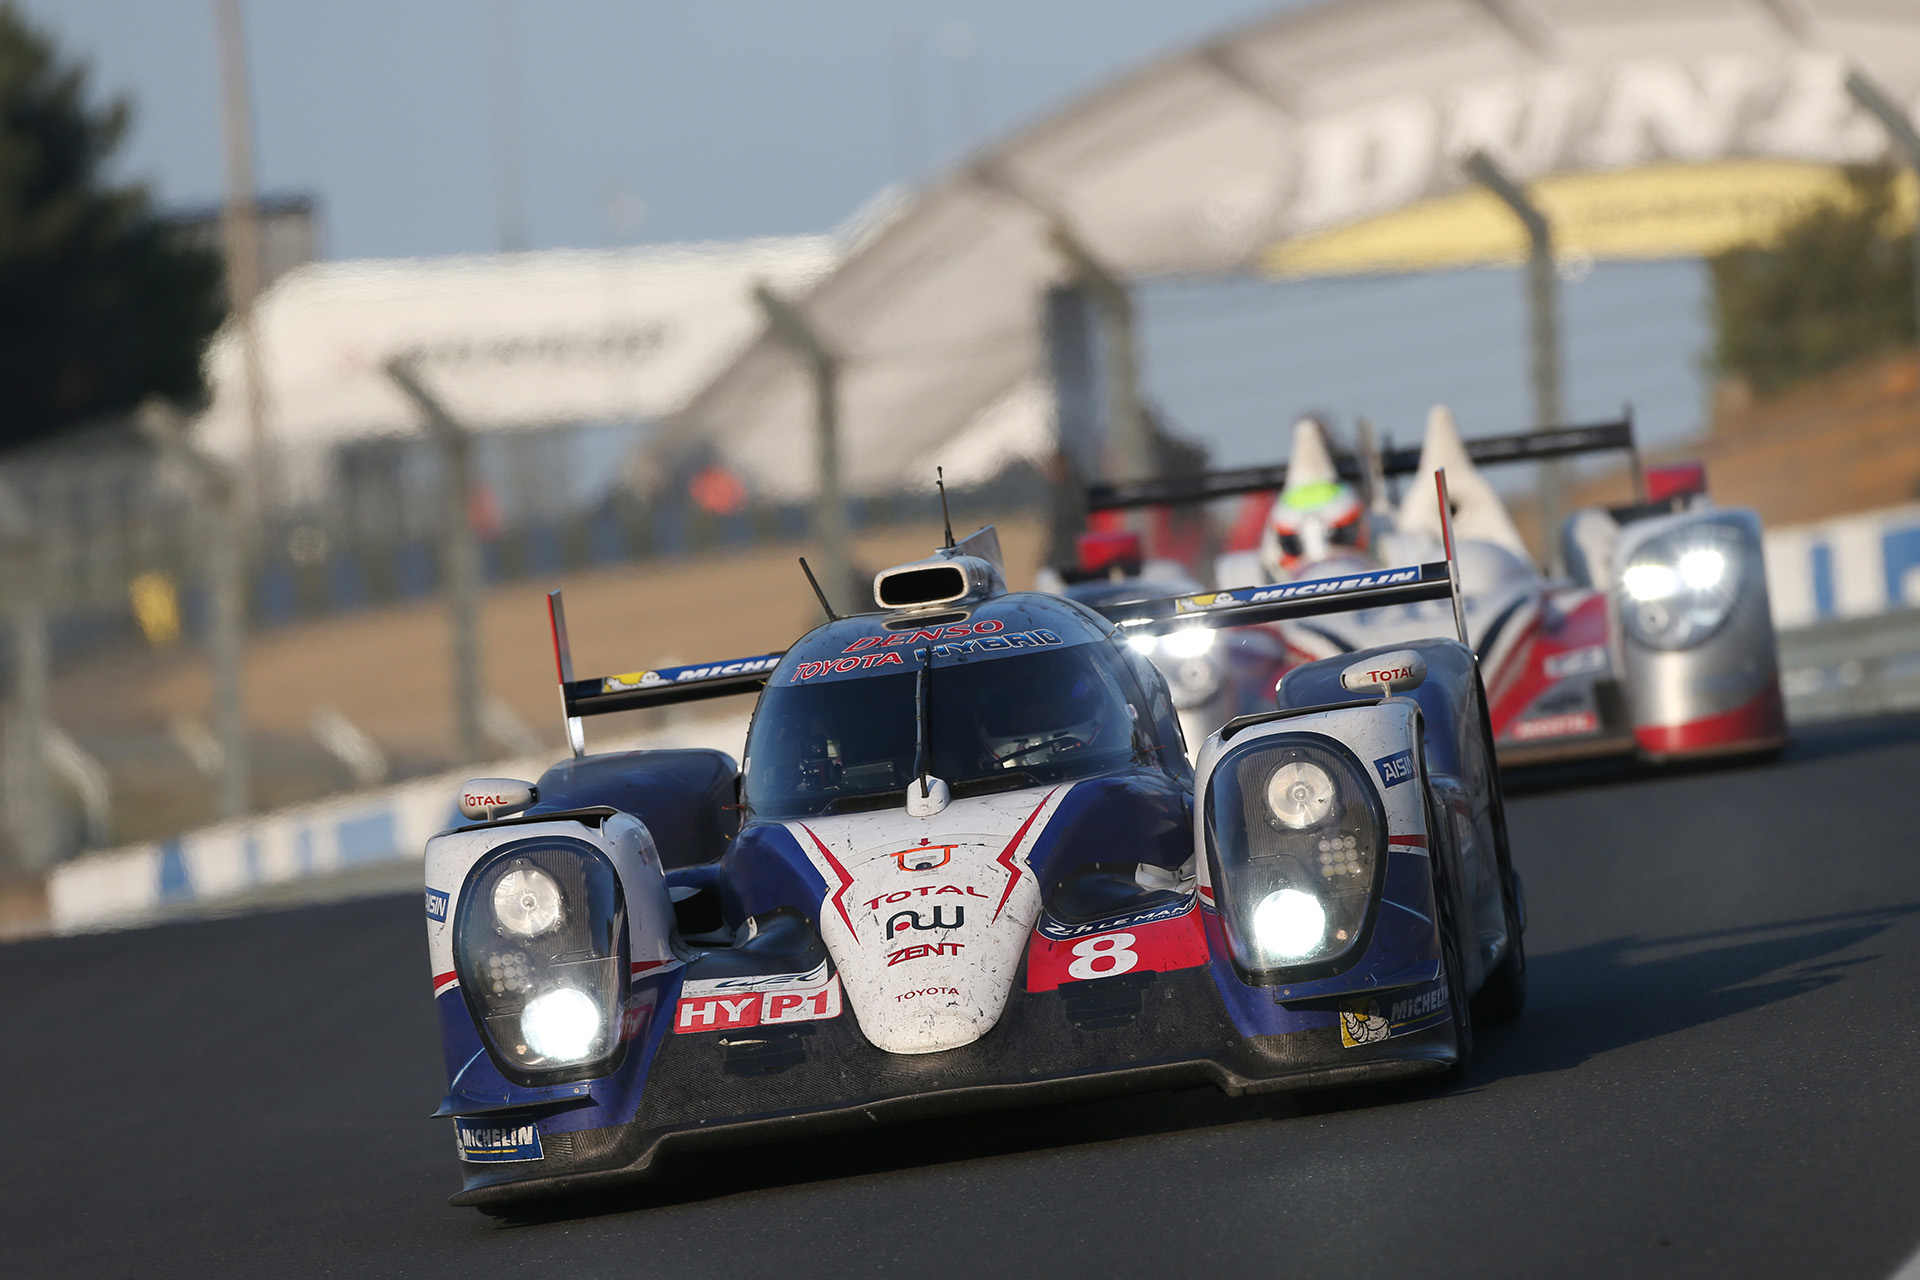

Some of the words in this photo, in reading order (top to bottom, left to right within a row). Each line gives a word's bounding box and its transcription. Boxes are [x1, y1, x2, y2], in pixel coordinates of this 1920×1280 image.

[1288, 52, 1920, 232] DUNL
[1250, 571, 1416, 601] MICHELIN
[842, 619, 1004, 654] DENSO
[790, 651, 904, 683] TOYOTA
[914, 628, 1064, 662] HYBRID
[1366, 666, 1415, 683] TOTAL
[464, 793, 508, 807] TOTAL
[863, 884, 989, 910] TOTAL
[887, 942, 965, 967] ZENT
[1068, 932, 1139, 980] 8
[679, 997, 756, 1027] HY
[769, 989, 829, 1020] P1
[895, 986, 960, 1003] TOYOTA
[462, 1125, 534, 1148] MICHELIN
